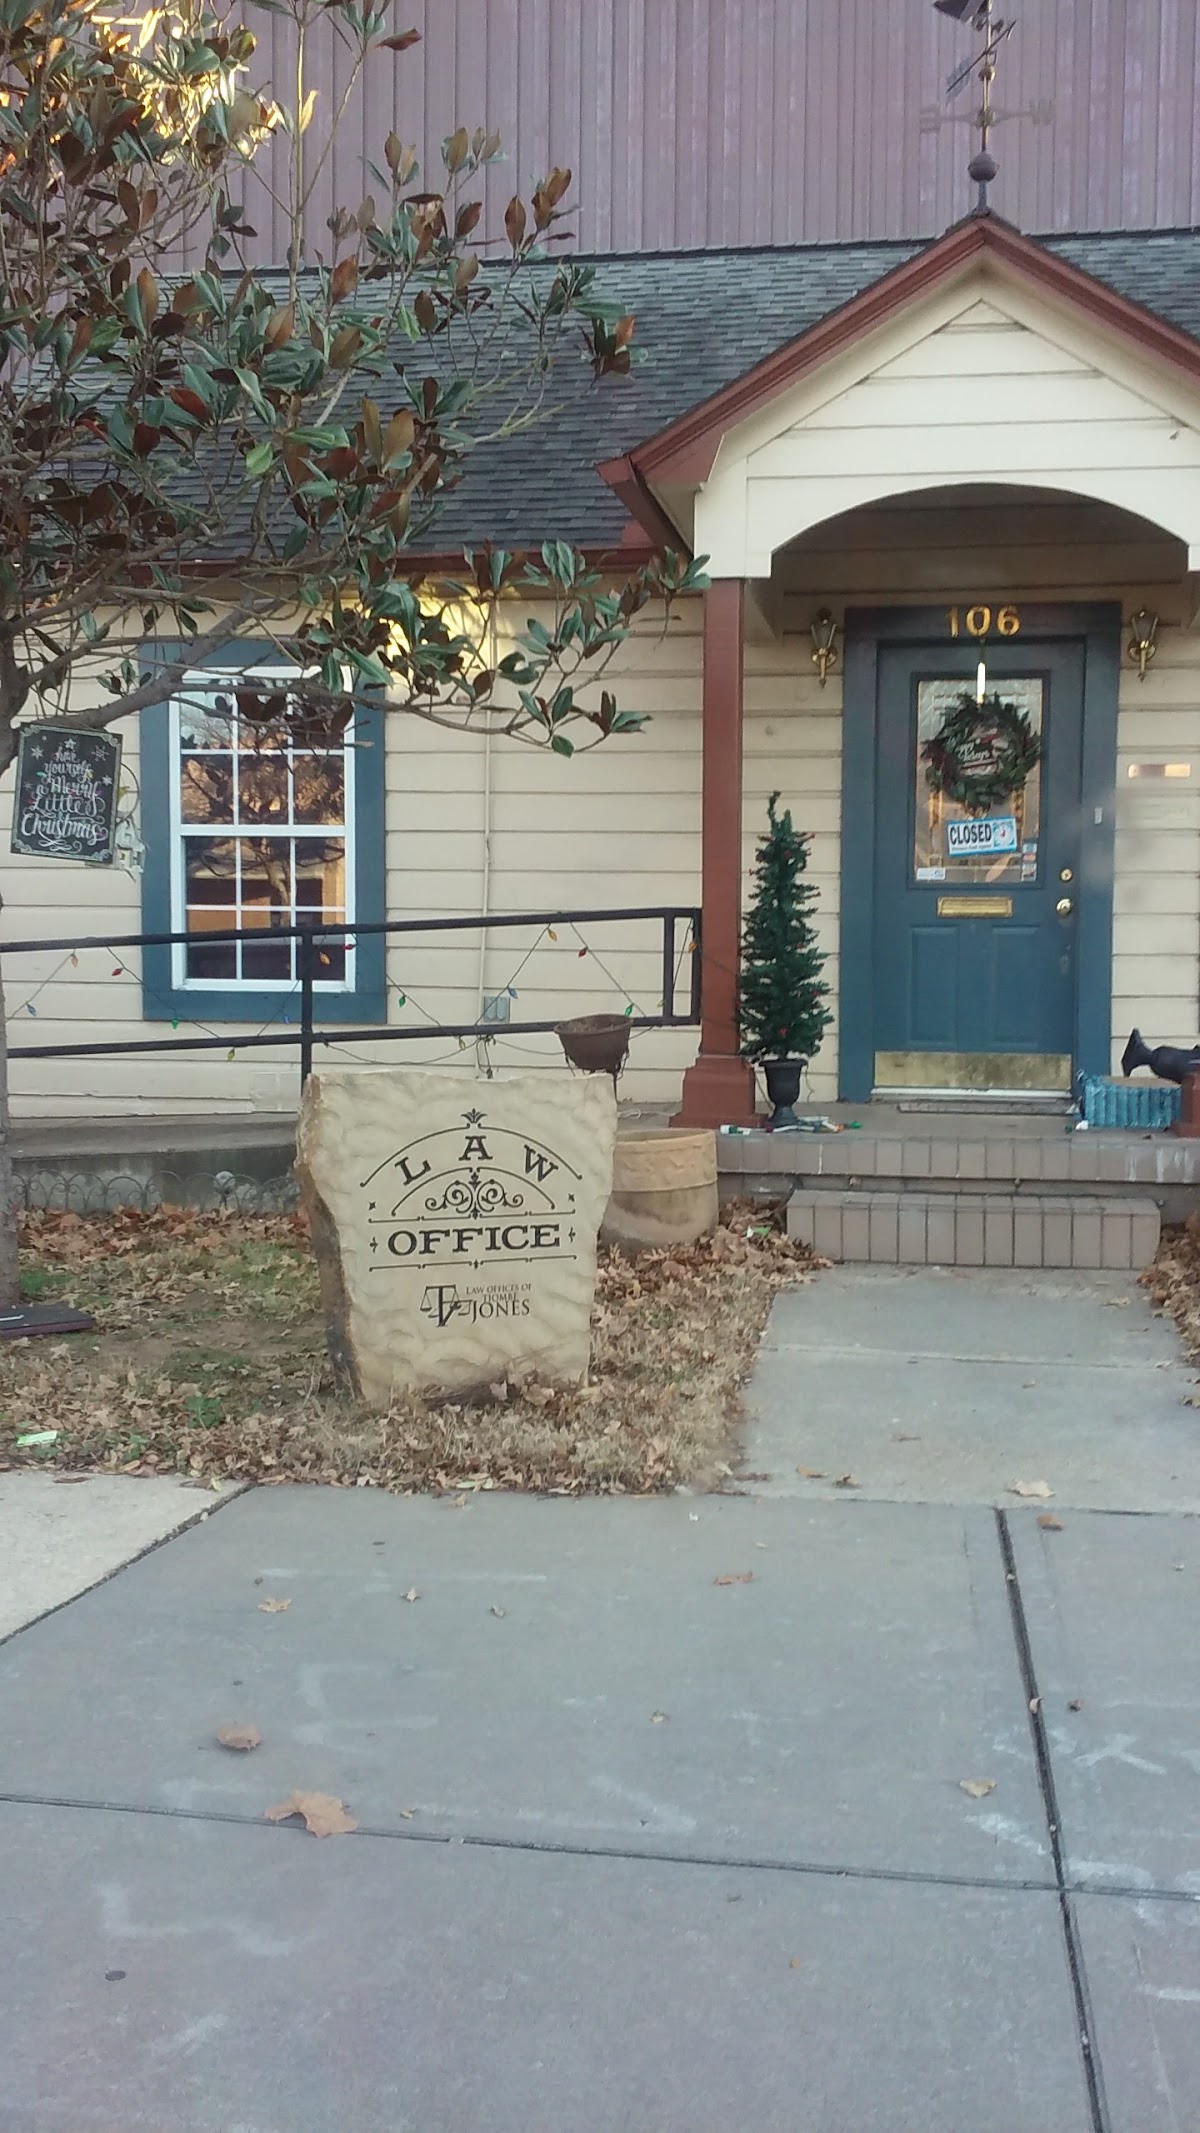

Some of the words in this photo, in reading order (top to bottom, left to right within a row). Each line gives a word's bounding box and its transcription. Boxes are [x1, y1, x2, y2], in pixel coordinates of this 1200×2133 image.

[945, 605, 1020, 637] 106
[44, 760, 93, 784] yourself
[22, 813, 107, 845] Christmas
[949, 823, 992, 845] CLOSED
[395, 1135, 559, 1185] LAW
[387, 1224, 560, 1256] OFFICE
[466, 1286, 484, 1295] LAW
[471, 1299, 530, 1325] JONES
